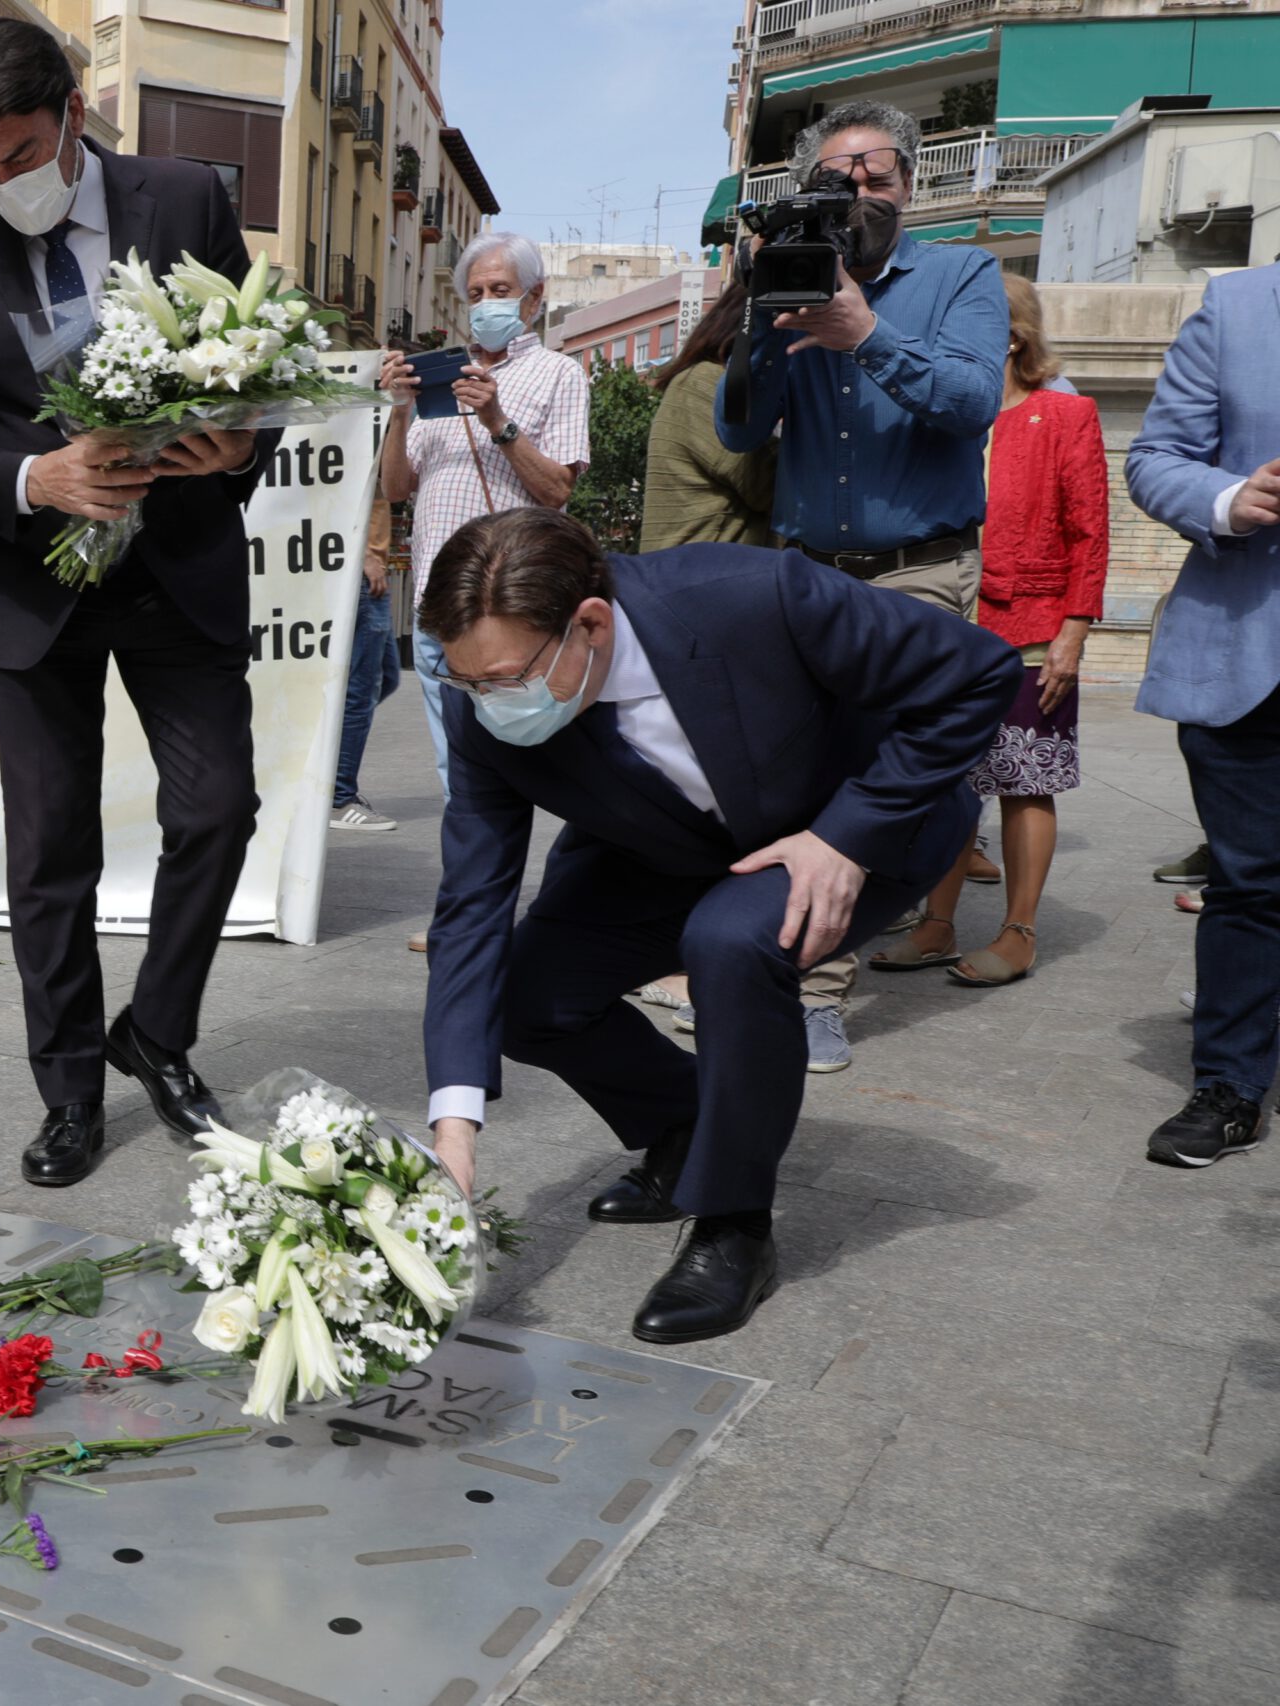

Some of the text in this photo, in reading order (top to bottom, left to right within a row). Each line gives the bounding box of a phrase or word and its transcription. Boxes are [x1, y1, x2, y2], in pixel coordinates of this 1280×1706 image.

[679, 301, 689, 336] ROOM
[741, 296, 752, 335] SONY
[263, 438, 344, 487] nte
[247, 535, 265, 575] n
[287, 518, 344, 574] de
[251, 607, 334, 662] rica
